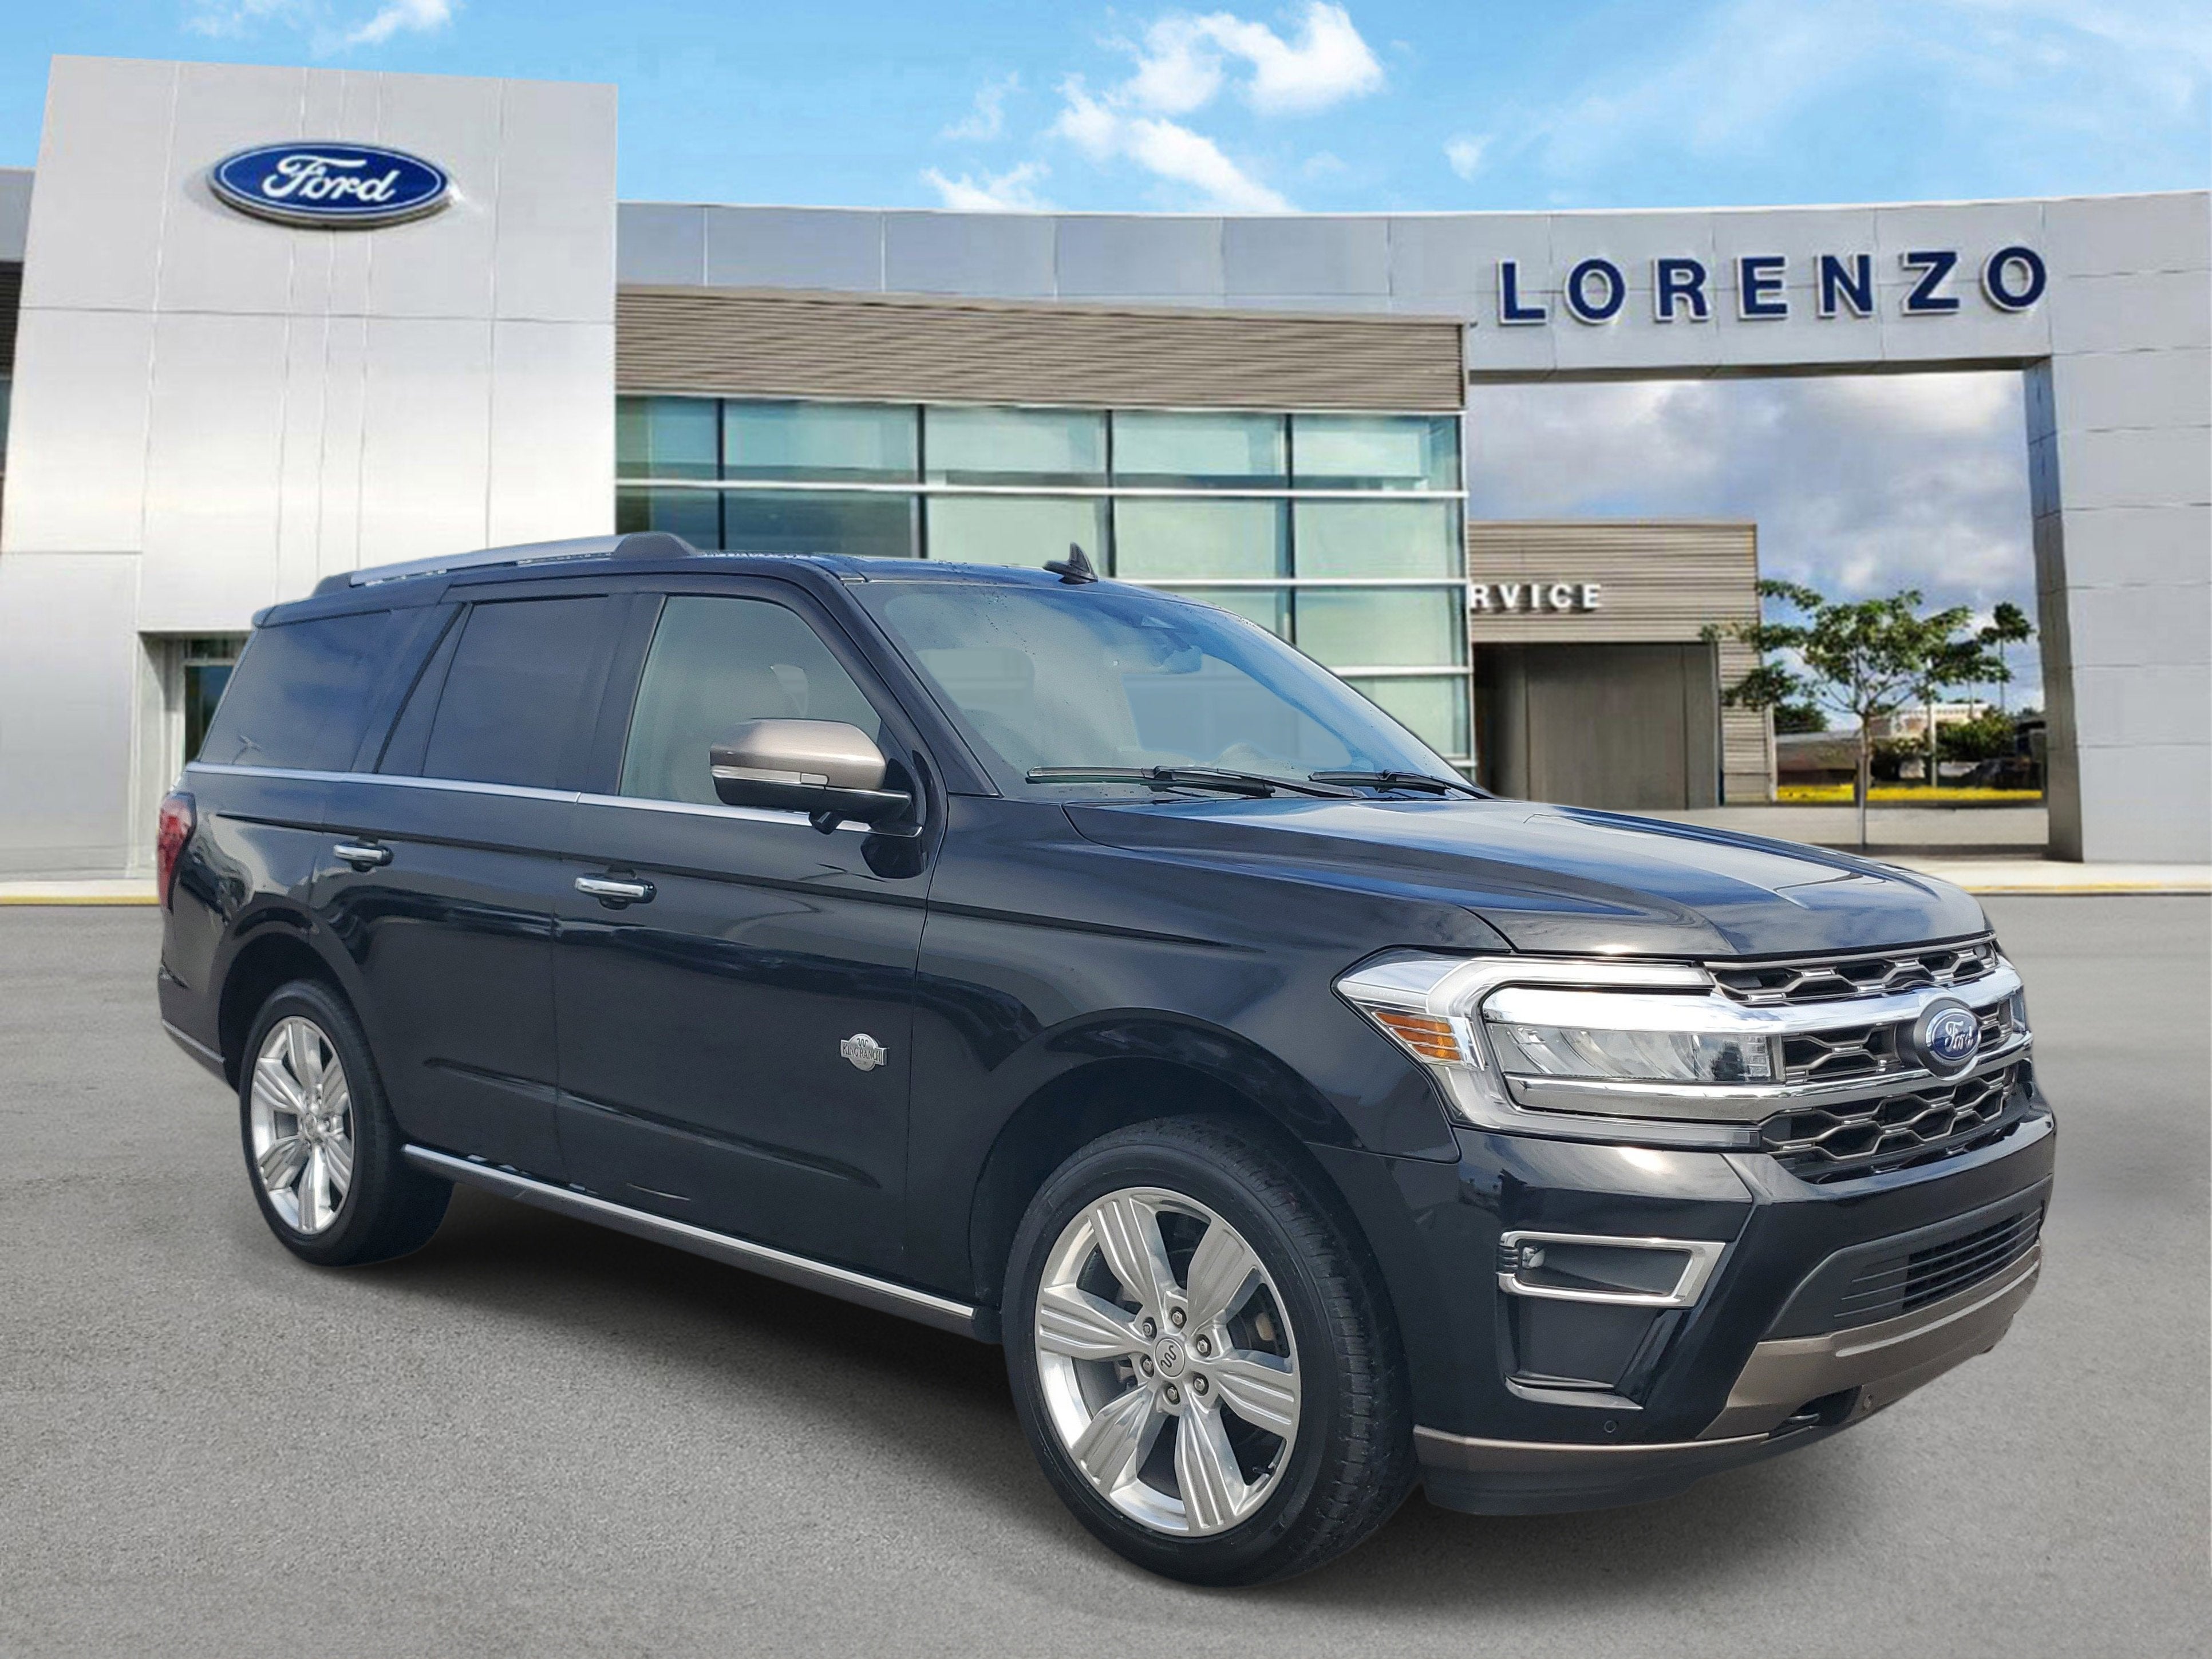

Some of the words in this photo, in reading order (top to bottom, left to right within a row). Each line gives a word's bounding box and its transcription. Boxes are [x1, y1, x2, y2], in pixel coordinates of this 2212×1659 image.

[262, 155, 401, 202] Ford
[1499, 246, 2047, 323] LORENZO
[1470, 584, 1601, 609] RVICE
[1945, 1021, 1974, 1052] Ford
[843, 1044, 859, 1057] KING
[859, 1048, 881, 1061] RANCH
